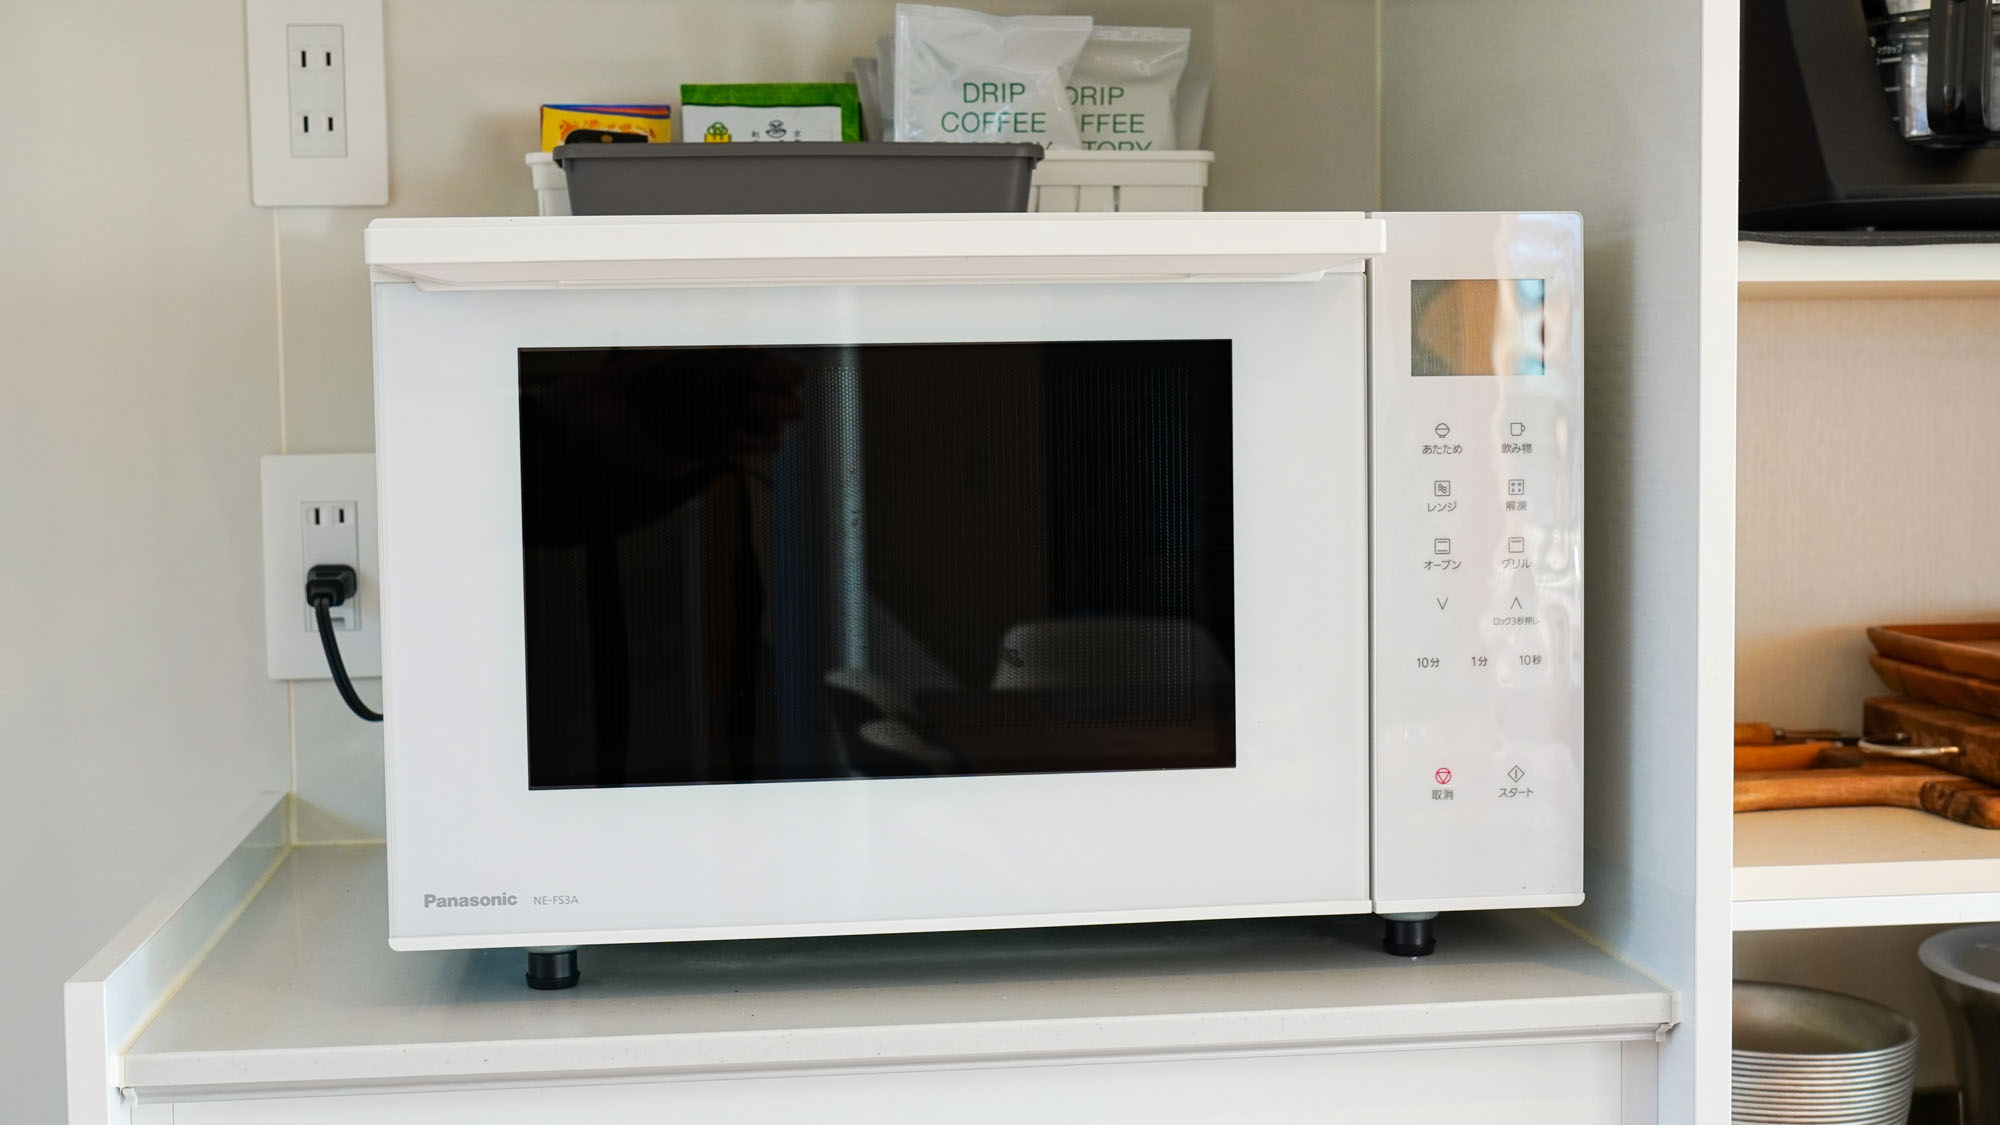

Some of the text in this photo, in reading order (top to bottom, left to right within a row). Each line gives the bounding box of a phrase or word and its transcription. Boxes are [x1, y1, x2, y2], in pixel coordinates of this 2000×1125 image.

[962, 82, 1026, 103] DRIP
[941, 111, 1046, 133] COFFEE
[1080, 113, 1145, 134] FFEE
[1422, 443, 1463, 455] あたため
[1501, 442, 1533, 454] 飲み物
[1427, 501, 1457, 513] レンジ
[1505, 500, 1528, 512] 解凍
[1423, 559, 1462, 571] オープン
[1501, 558, 1532, 570] グリル
[1492, 616, 1540, 626] ロック3秒押し
[1416, 656, 1441, 669] 10分
[1471, 656, 1489, 668] 1分
[1519, 654, 1543, 667] 10秒
[1431, 789, 1454, 801] 取消
[1498, 787, 1535, 799] スタート
[423, 892, 579, 908] Panasonic NE-FS3A
